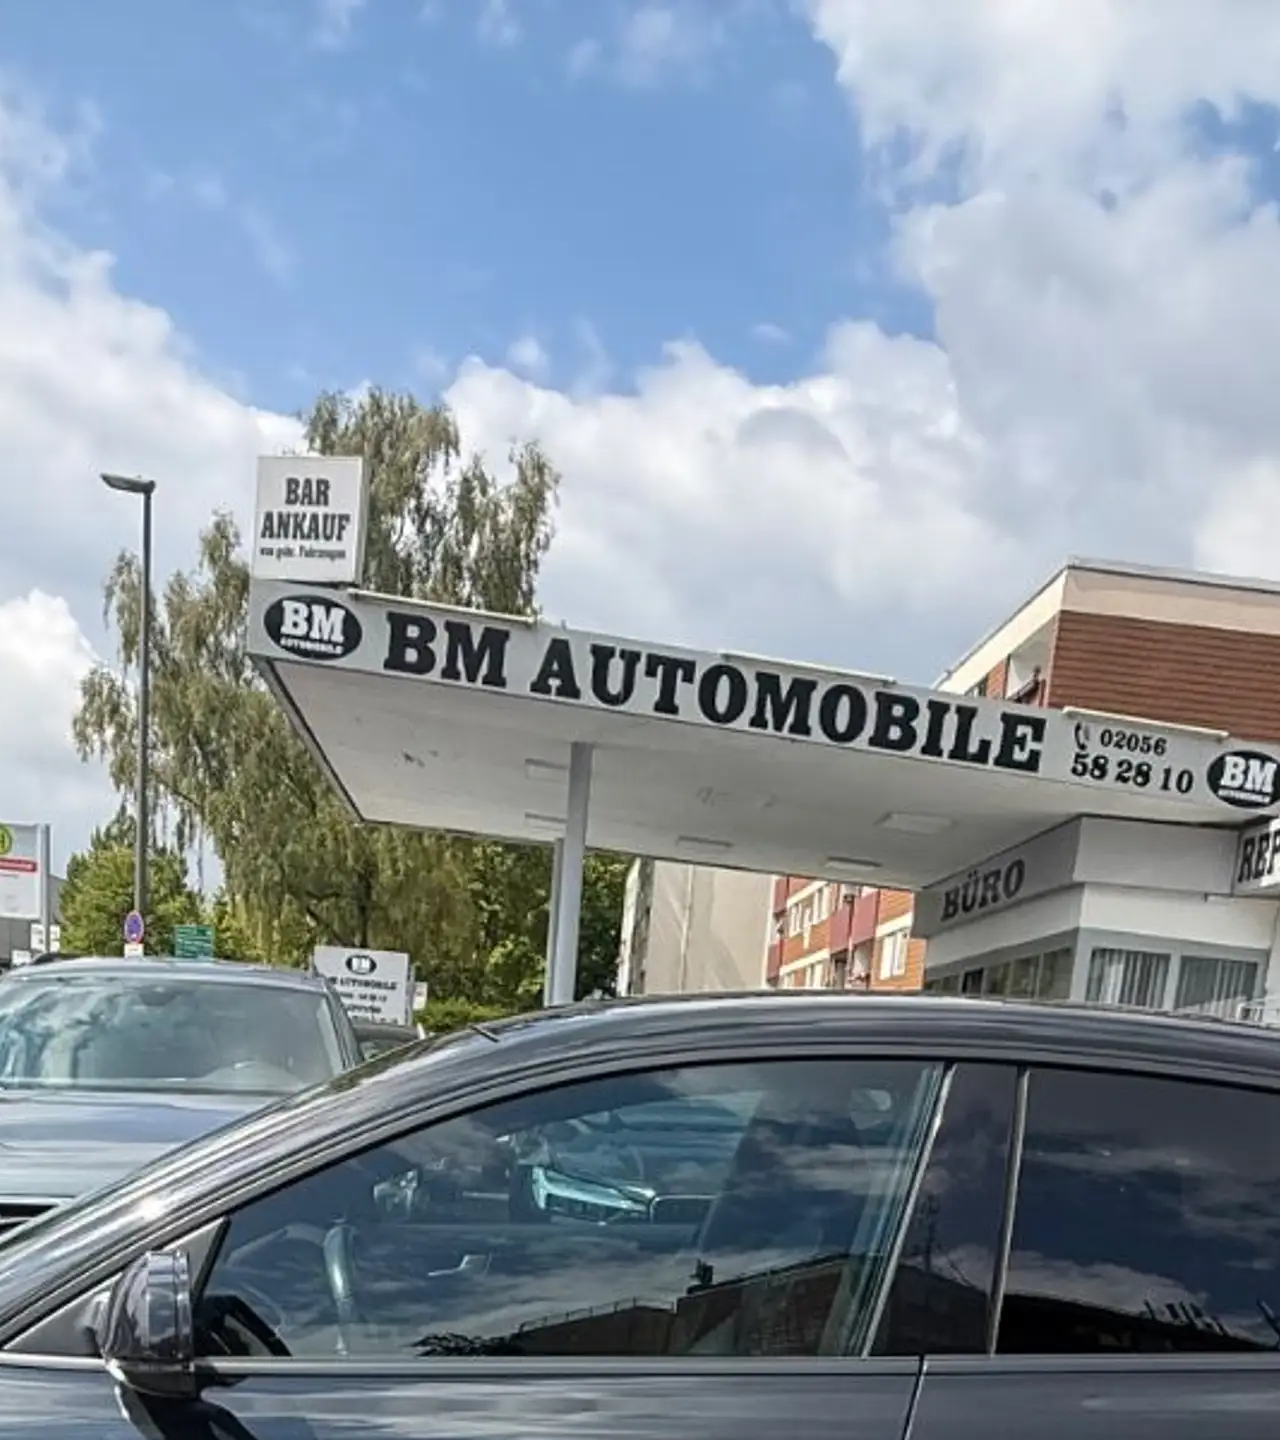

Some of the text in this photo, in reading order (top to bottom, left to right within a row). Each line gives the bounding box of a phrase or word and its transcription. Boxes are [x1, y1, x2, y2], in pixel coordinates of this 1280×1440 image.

[285, 477, 330, 506] BAR
[260, 511, 351, 542] ANKAUF
[280, 600, 346, 644] BM
[383, 610, 1047, 774] BM AUTOMOBILE
[1100, 728, 1167, 757] 02056
[1071, 752, 1194, 794] 58 28 10
[1219, 755, 1278, 793] BM
[940, 859, 1026, 923] BÜRO
